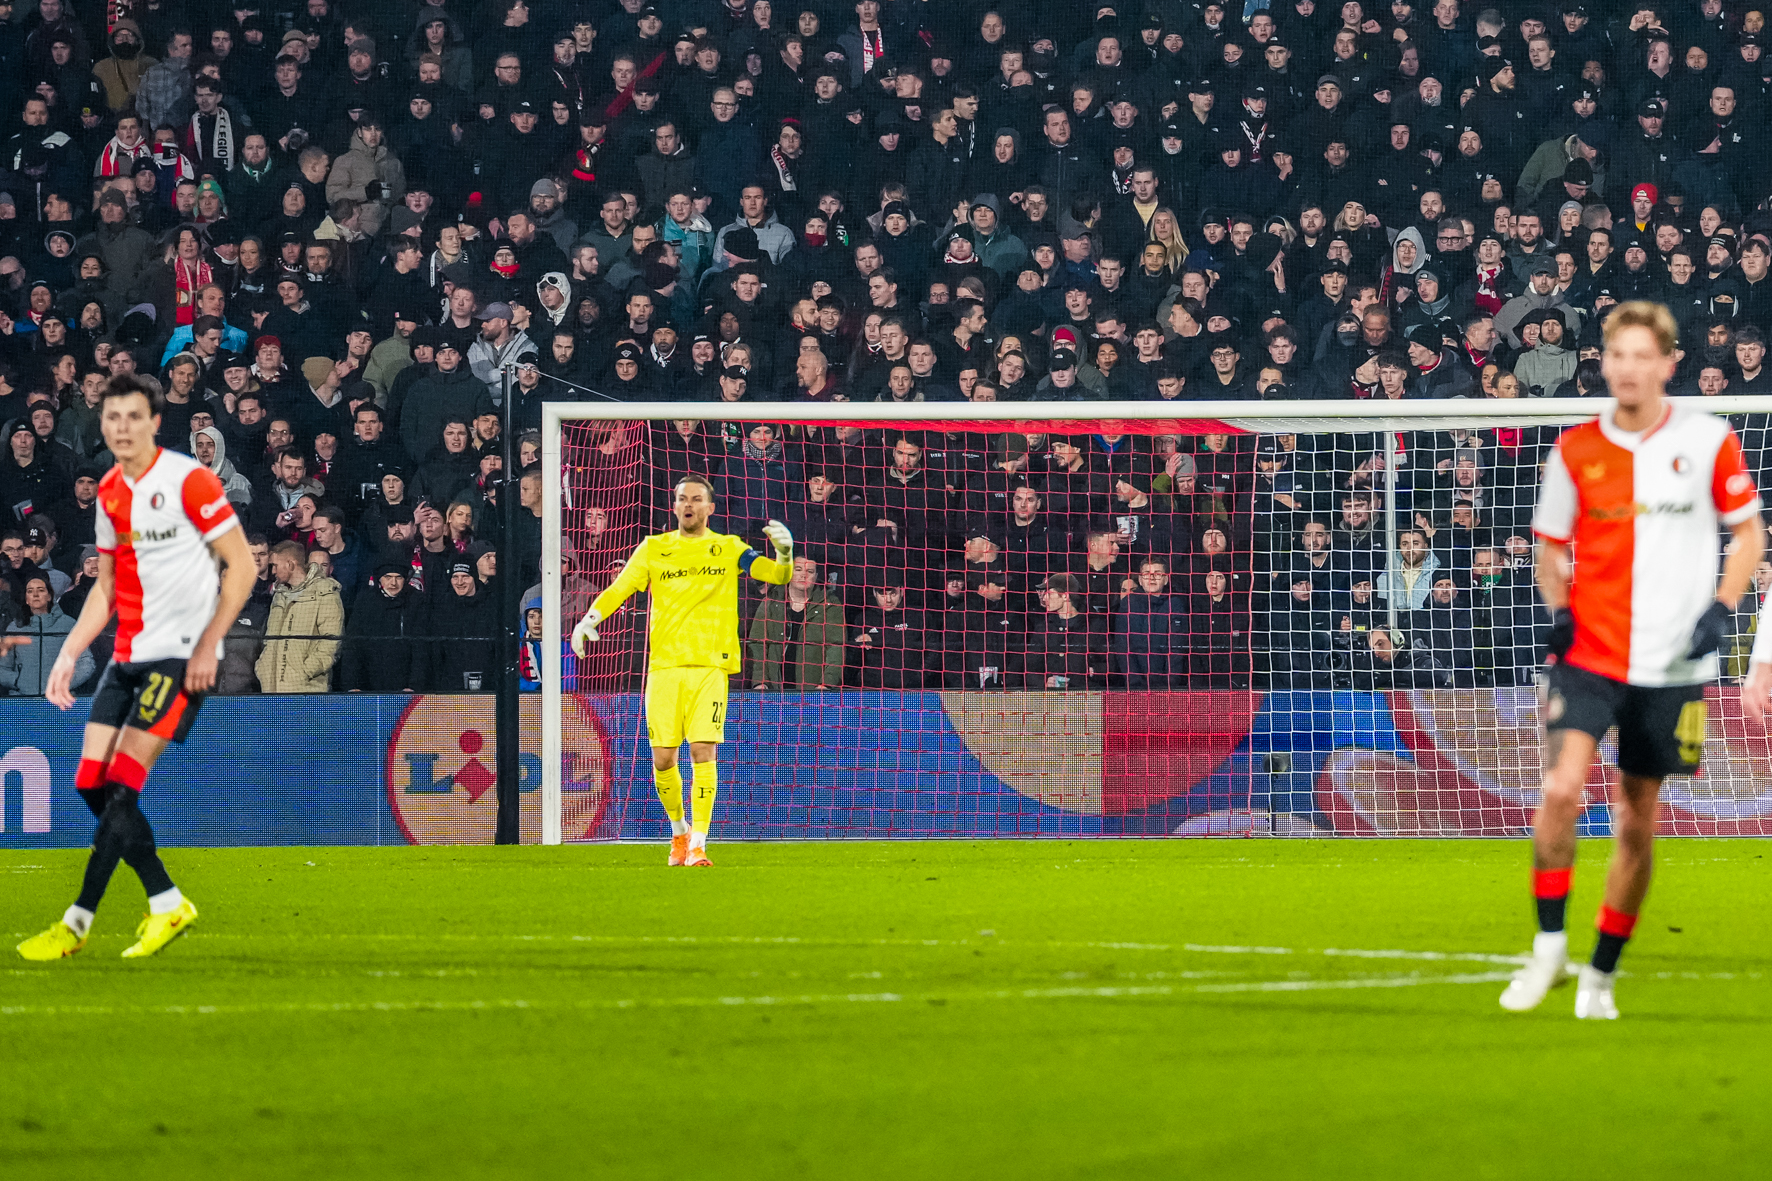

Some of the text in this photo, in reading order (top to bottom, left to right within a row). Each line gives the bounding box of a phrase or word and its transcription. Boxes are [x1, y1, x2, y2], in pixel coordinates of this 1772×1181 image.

[660, 566, 726, 581] Media Markt
[139, 672, 173, 710] 21
